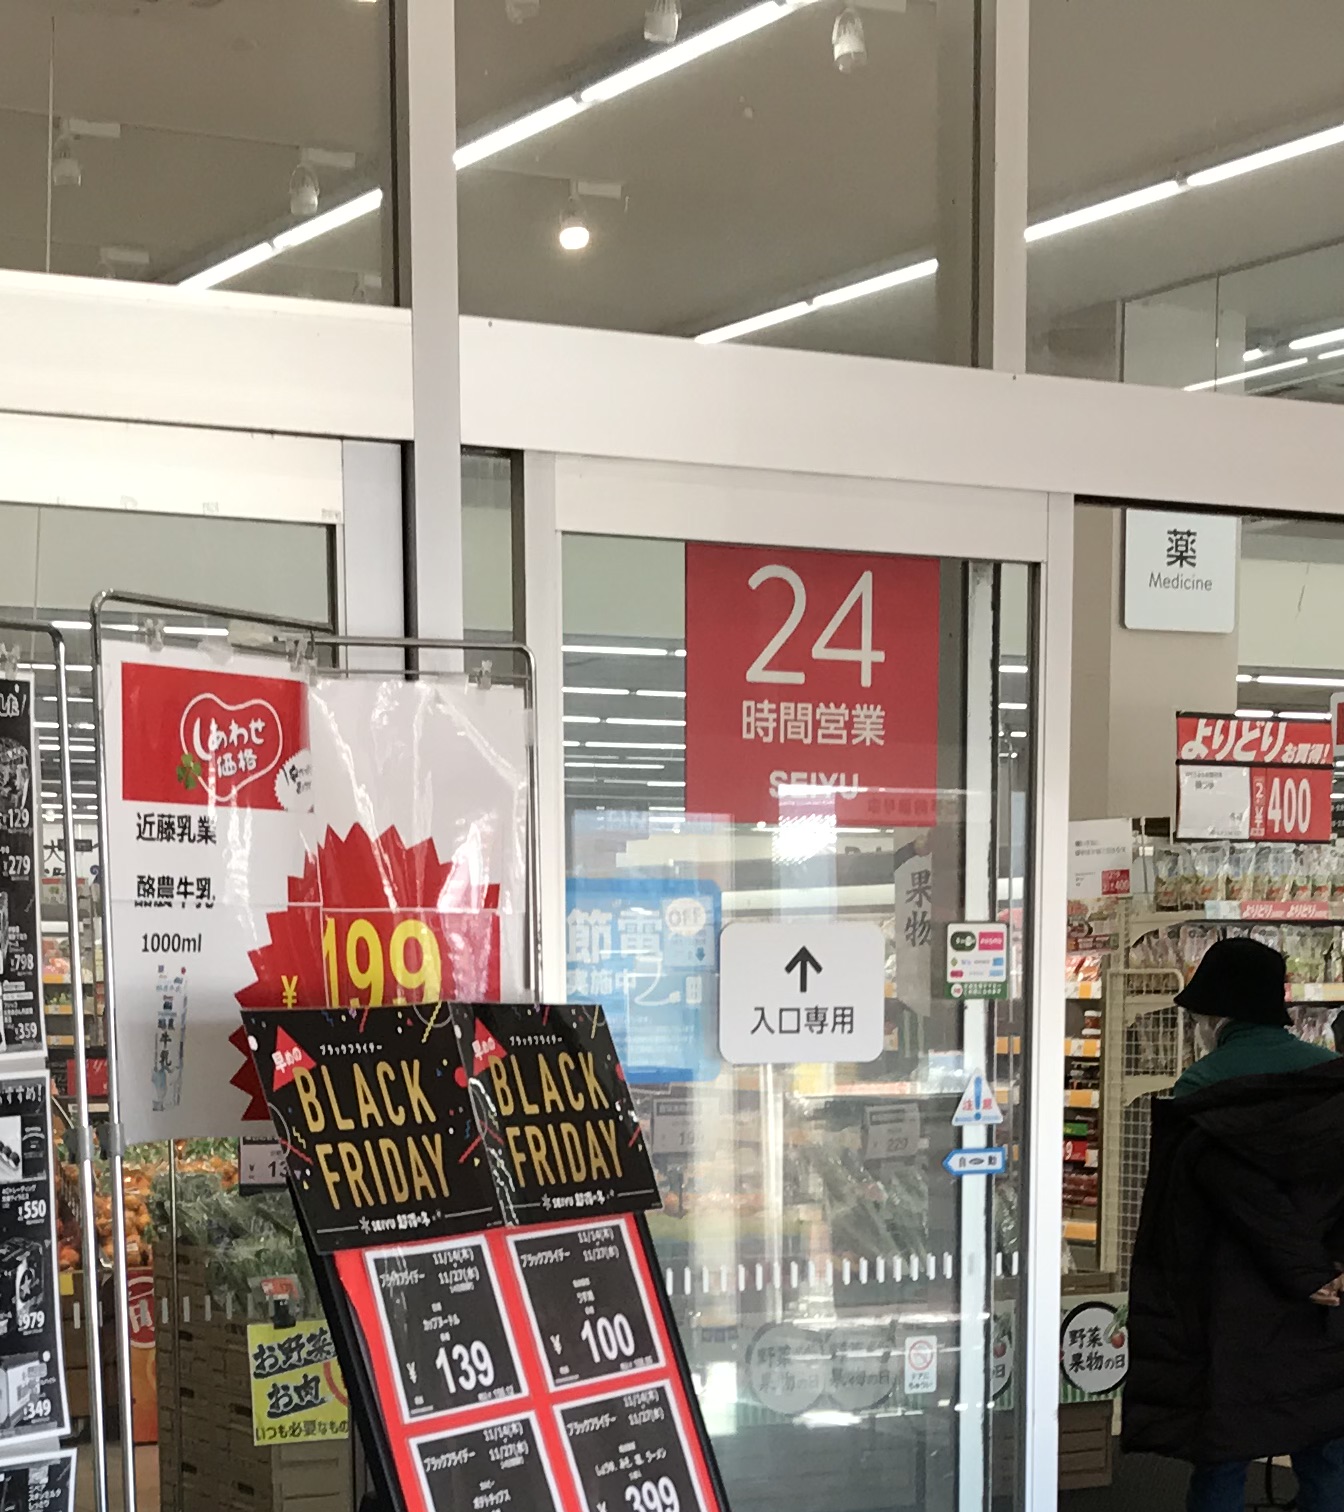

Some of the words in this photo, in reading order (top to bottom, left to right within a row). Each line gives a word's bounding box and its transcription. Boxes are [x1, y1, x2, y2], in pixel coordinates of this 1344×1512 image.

[1166, 529, 1198, 568] 薬
[1149, 572, 1213, 592] Medicine
[746, 565, 885, 688] 24
[192, 716, 267, 762] しあわせ
[742, 700, 886, 746] 時間営業
[1181, 718, 1287, 764] よりどり
[215, 749, 258, 779] 価格
[769, 770, 862, 800] SEIYU
[7, 808, 30, 828] 129
[1267, 777, 1312, 834] 400
[135, 812, 217, 847] 近藤乳業
[8, 855, 31, 875] 279
[134, 874, 215, 904] 酪農牛乳
[905, 869, 933, 946] 果物
[140, 932, 202, 955] 1000ml
[567, 906, 663, 964] 節電
[14, 953, 35, 971] 798
[321, 915, 444, 1009] 199
[17, 1021, 38, 1039] 359
[751, 1004, 856, 1037] 入口専用
[271, 1047, 303, 1074] 早めの
[292, 1058, 437, 1133] BLACK
[488, 1051, 610, 1117] BLACK
[506, 1118, 623, 1188] FRIDAY
[315, 1132, 450, 1211] FRIDAY
[23, 1199, 47, 1220] 550
[22, 1310, 45, 1330] 979
[1068, 1326, 1103, 1348] 野菜
[581, 1312, 636, 1364] 100
[435, 1339, 495, 1394] 139
[1068, 1352, 1127, 1373] 果物の日
[26, 1398, 52, 1419] 349
[266, 1373, 324, 1415] お肉
[255, 1417, 349, 1442] いつも必要なもの
